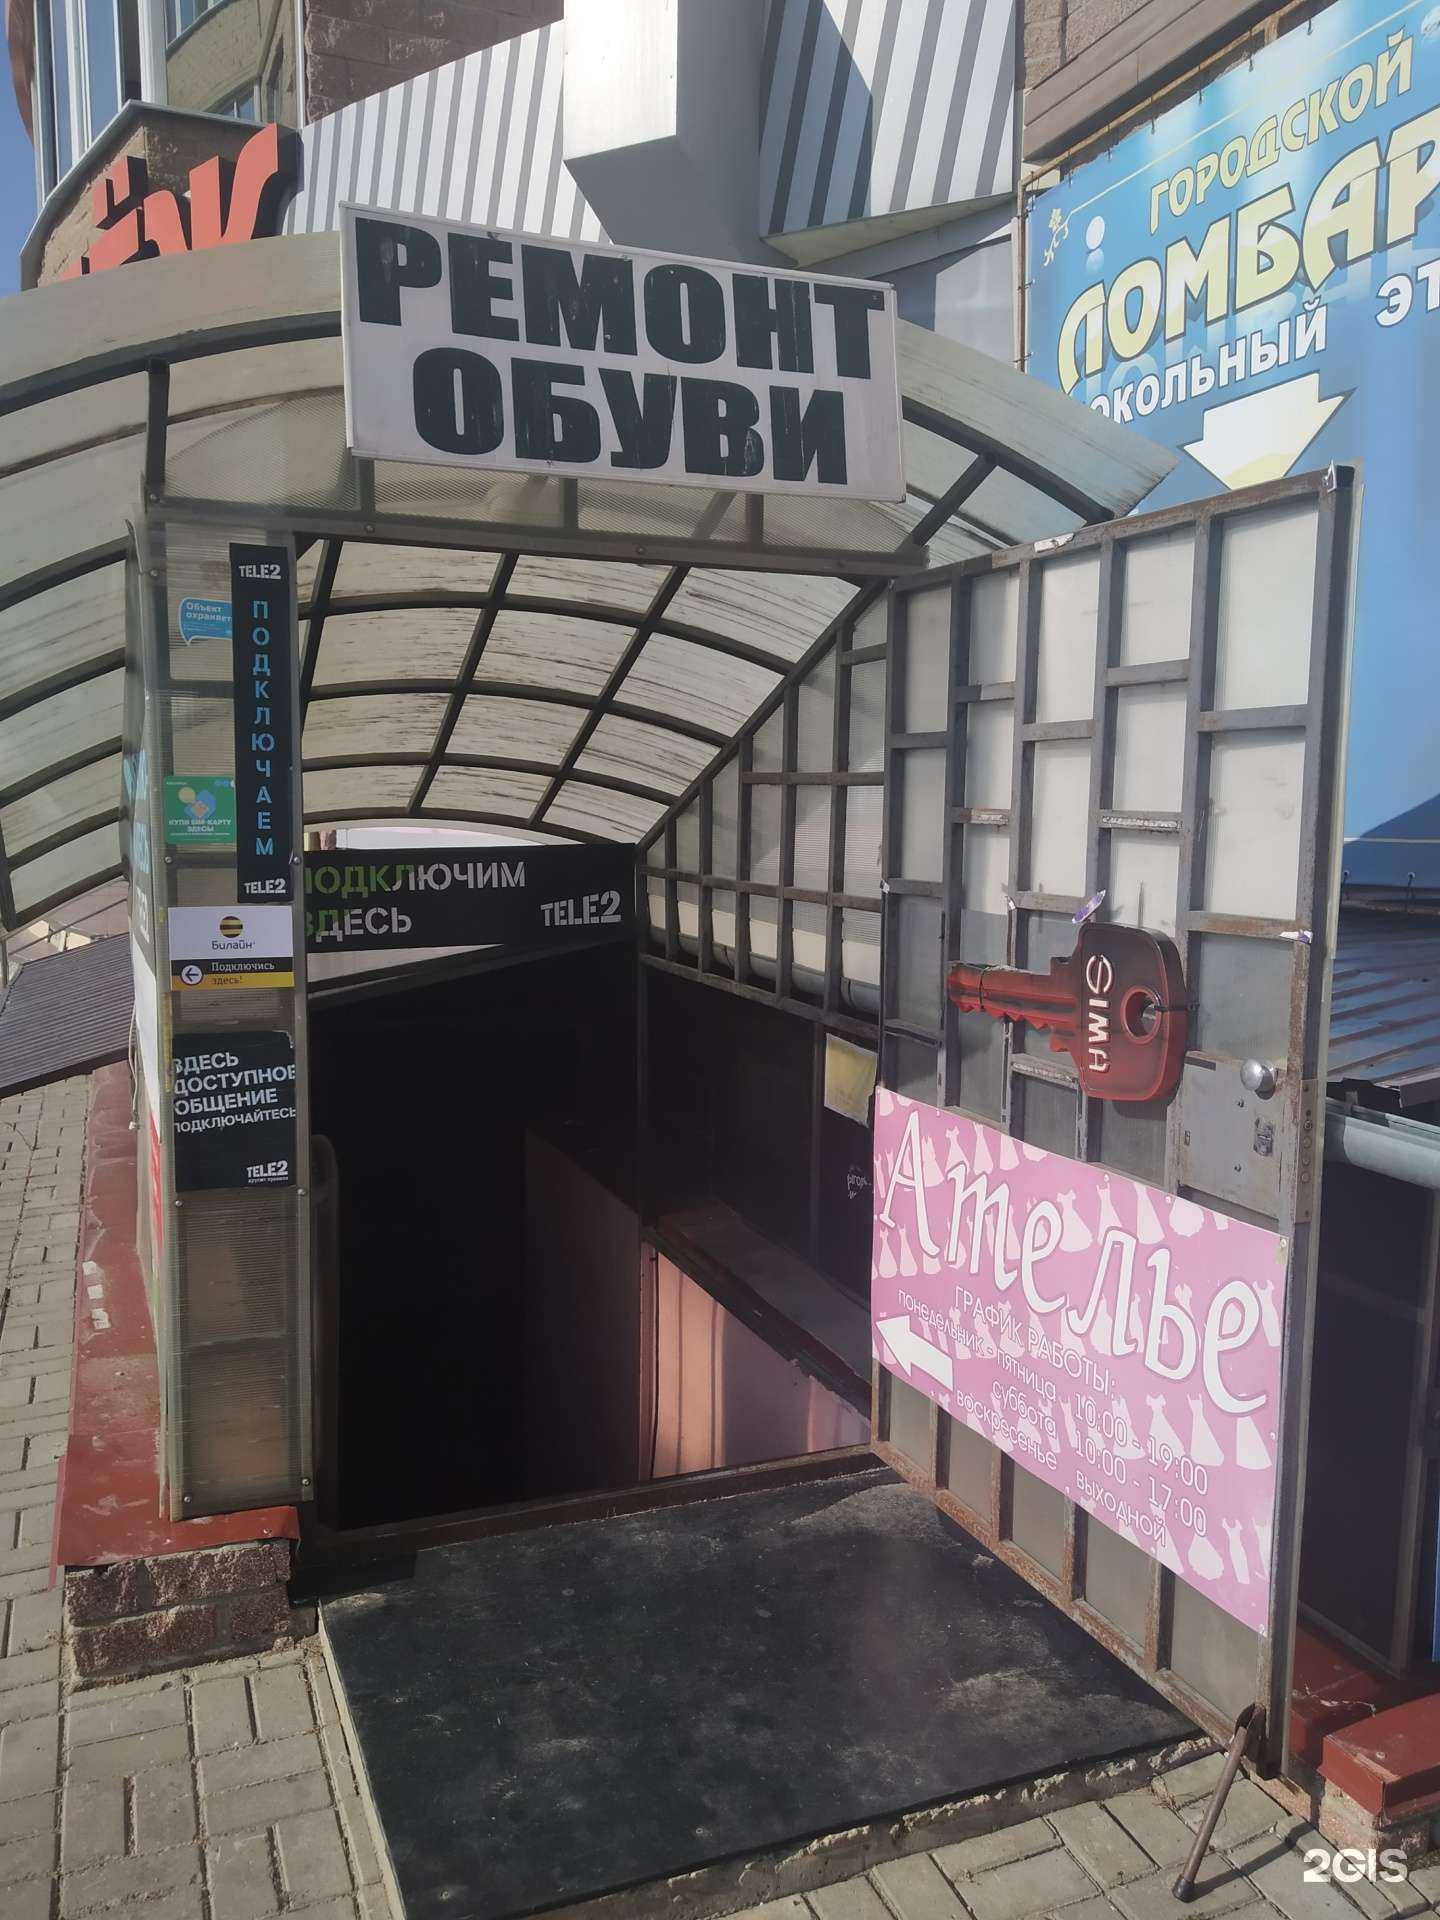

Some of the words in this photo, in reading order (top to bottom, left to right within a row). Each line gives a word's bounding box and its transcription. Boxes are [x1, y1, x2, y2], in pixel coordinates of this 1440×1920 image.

[1150, 27, 1413, 235] ГОРОДСКОЙ
[355, 216, 885, 380] РЕМОНТ
[413, 346, 848, 486] ОБУВИ
[238, 564, 281, 579] TELE2
[251, 600, 275, 856] ПОДКЛЮЧАЕМ
[244, 877, 287, 895] TELE2
[540, 890, 621, 927] TELE2
[211, 976, 243, 985] здесь!
[212, 962, 275, 973] Подключись
[174, 1088, 278, 1115] ОБЩЕНИЕ
[247, 1160, 288, 1178] TELE2
[879, 1110, 1267, 1415] Ателье
[955, 1286, 1023, 1348] ГРАФИК
[1028, 1328, 1116, 1398] РАБОТЫ:
[1074, 1392, 1127, 1447] 10:00
[1148, 1437, 1208, 1496] 19:00
[1074, 1430, 1126, 1485] 10:00
[1148, 1476, 1207, 1537] 17:00
